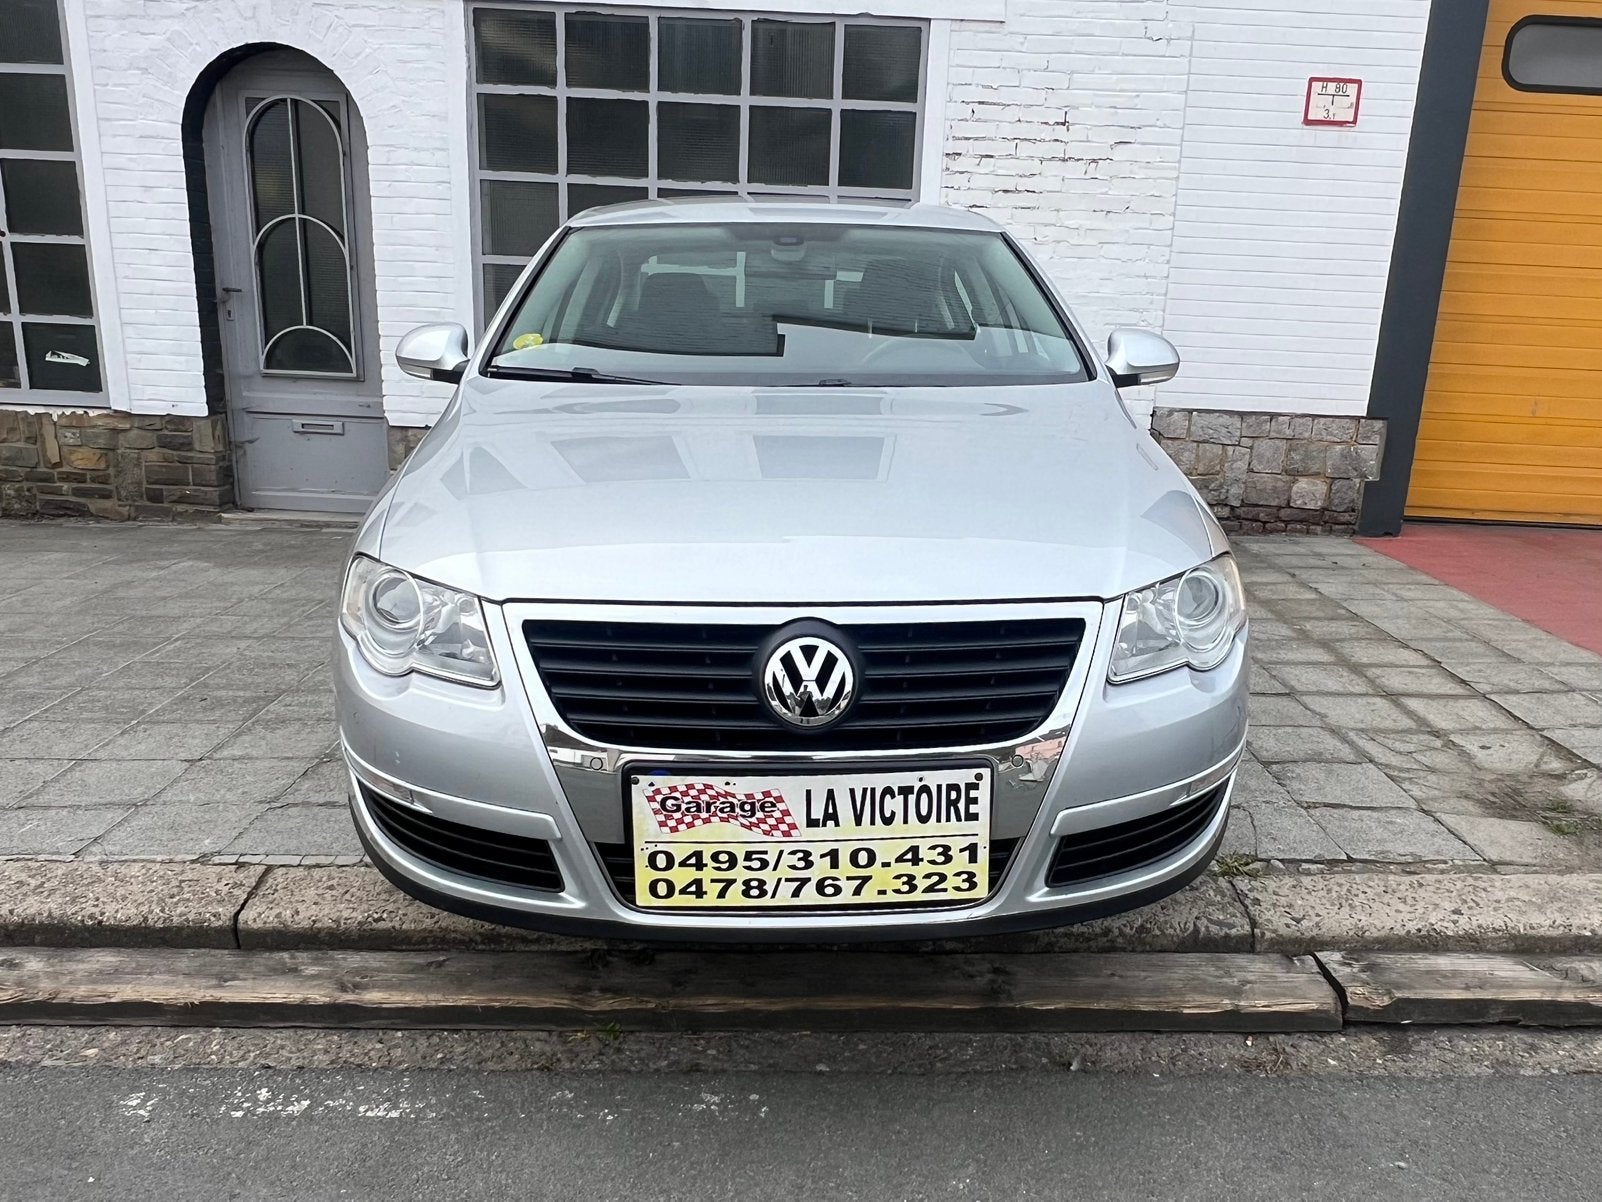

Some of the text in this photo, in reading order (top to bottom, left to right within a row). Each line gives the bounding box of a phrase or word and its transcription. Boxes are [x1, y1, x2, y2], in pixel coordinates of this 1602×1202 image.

[1321, 82, 1348, 94] H 80
[764, 637, 853, 726] VW
[659, 782, 980, 828] Garage LA VICTOIRE
[647, 843, 978, 872] 0495/310.431
[648, 870, 978, 900] 0478/767.323
